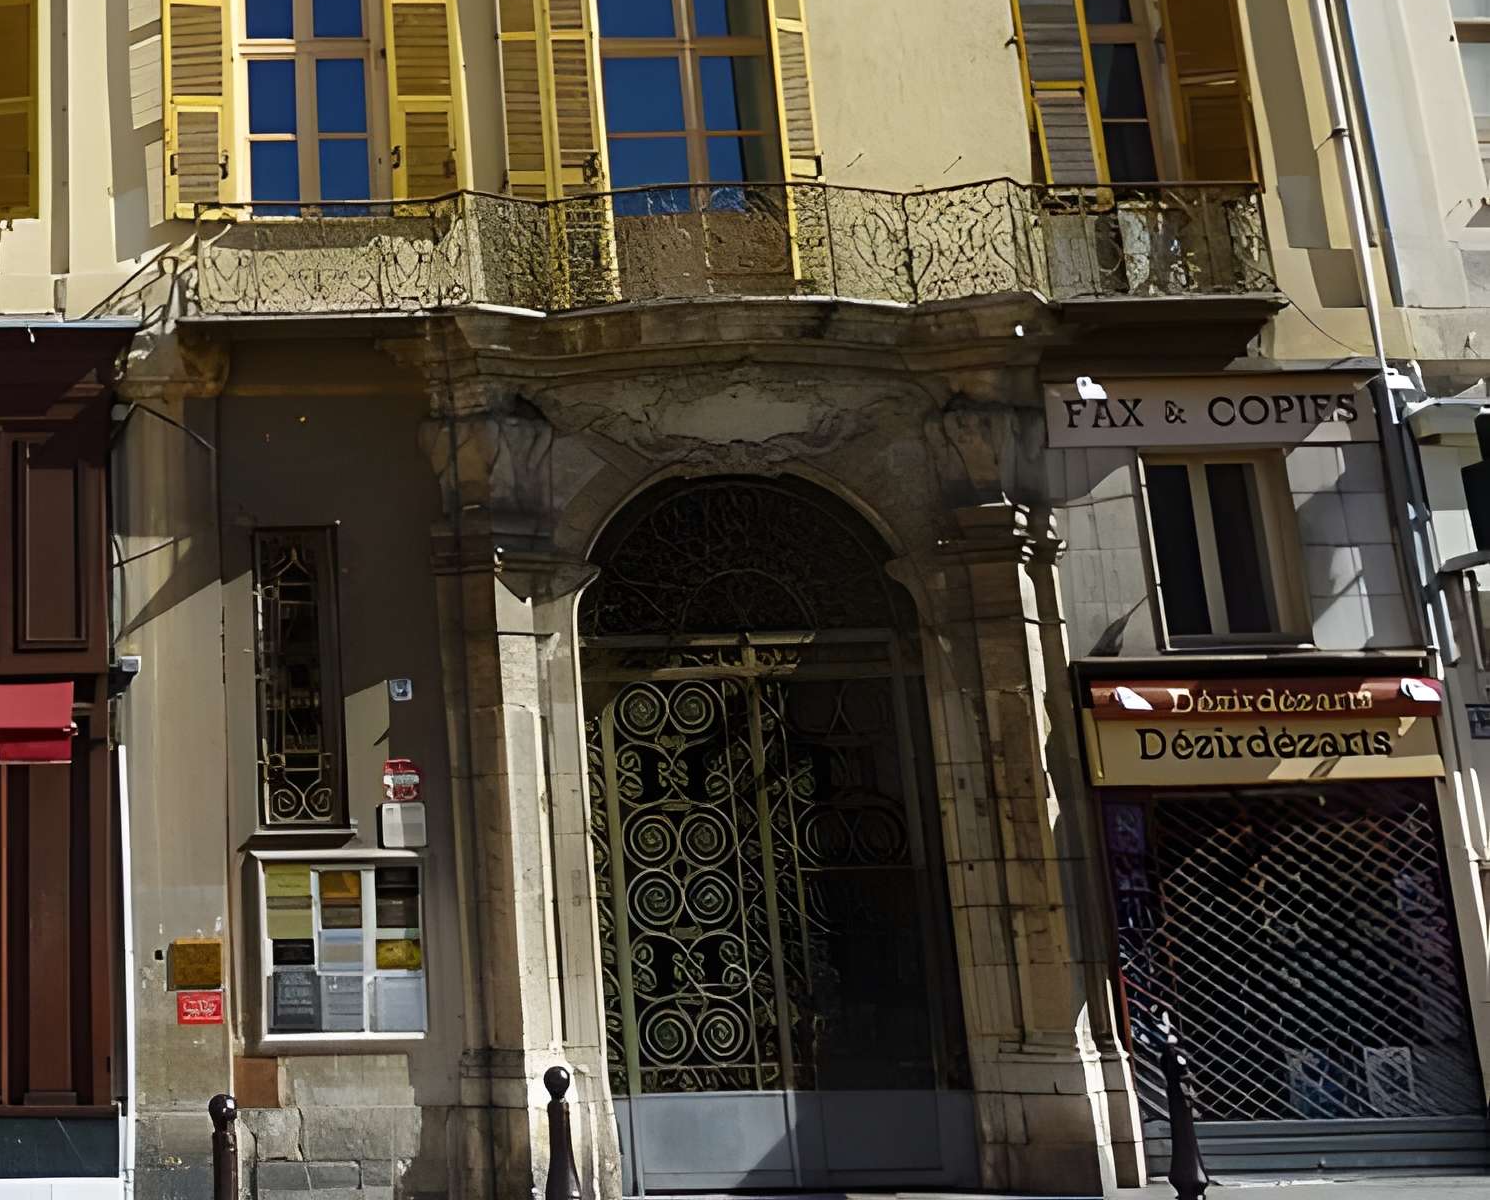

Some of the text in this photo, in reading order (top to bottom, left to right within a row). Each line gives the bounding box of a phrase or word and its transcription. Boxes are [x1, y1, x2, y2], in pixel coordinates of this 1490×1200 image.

[1062, 393, 1359, 429] FAX & COPIES
